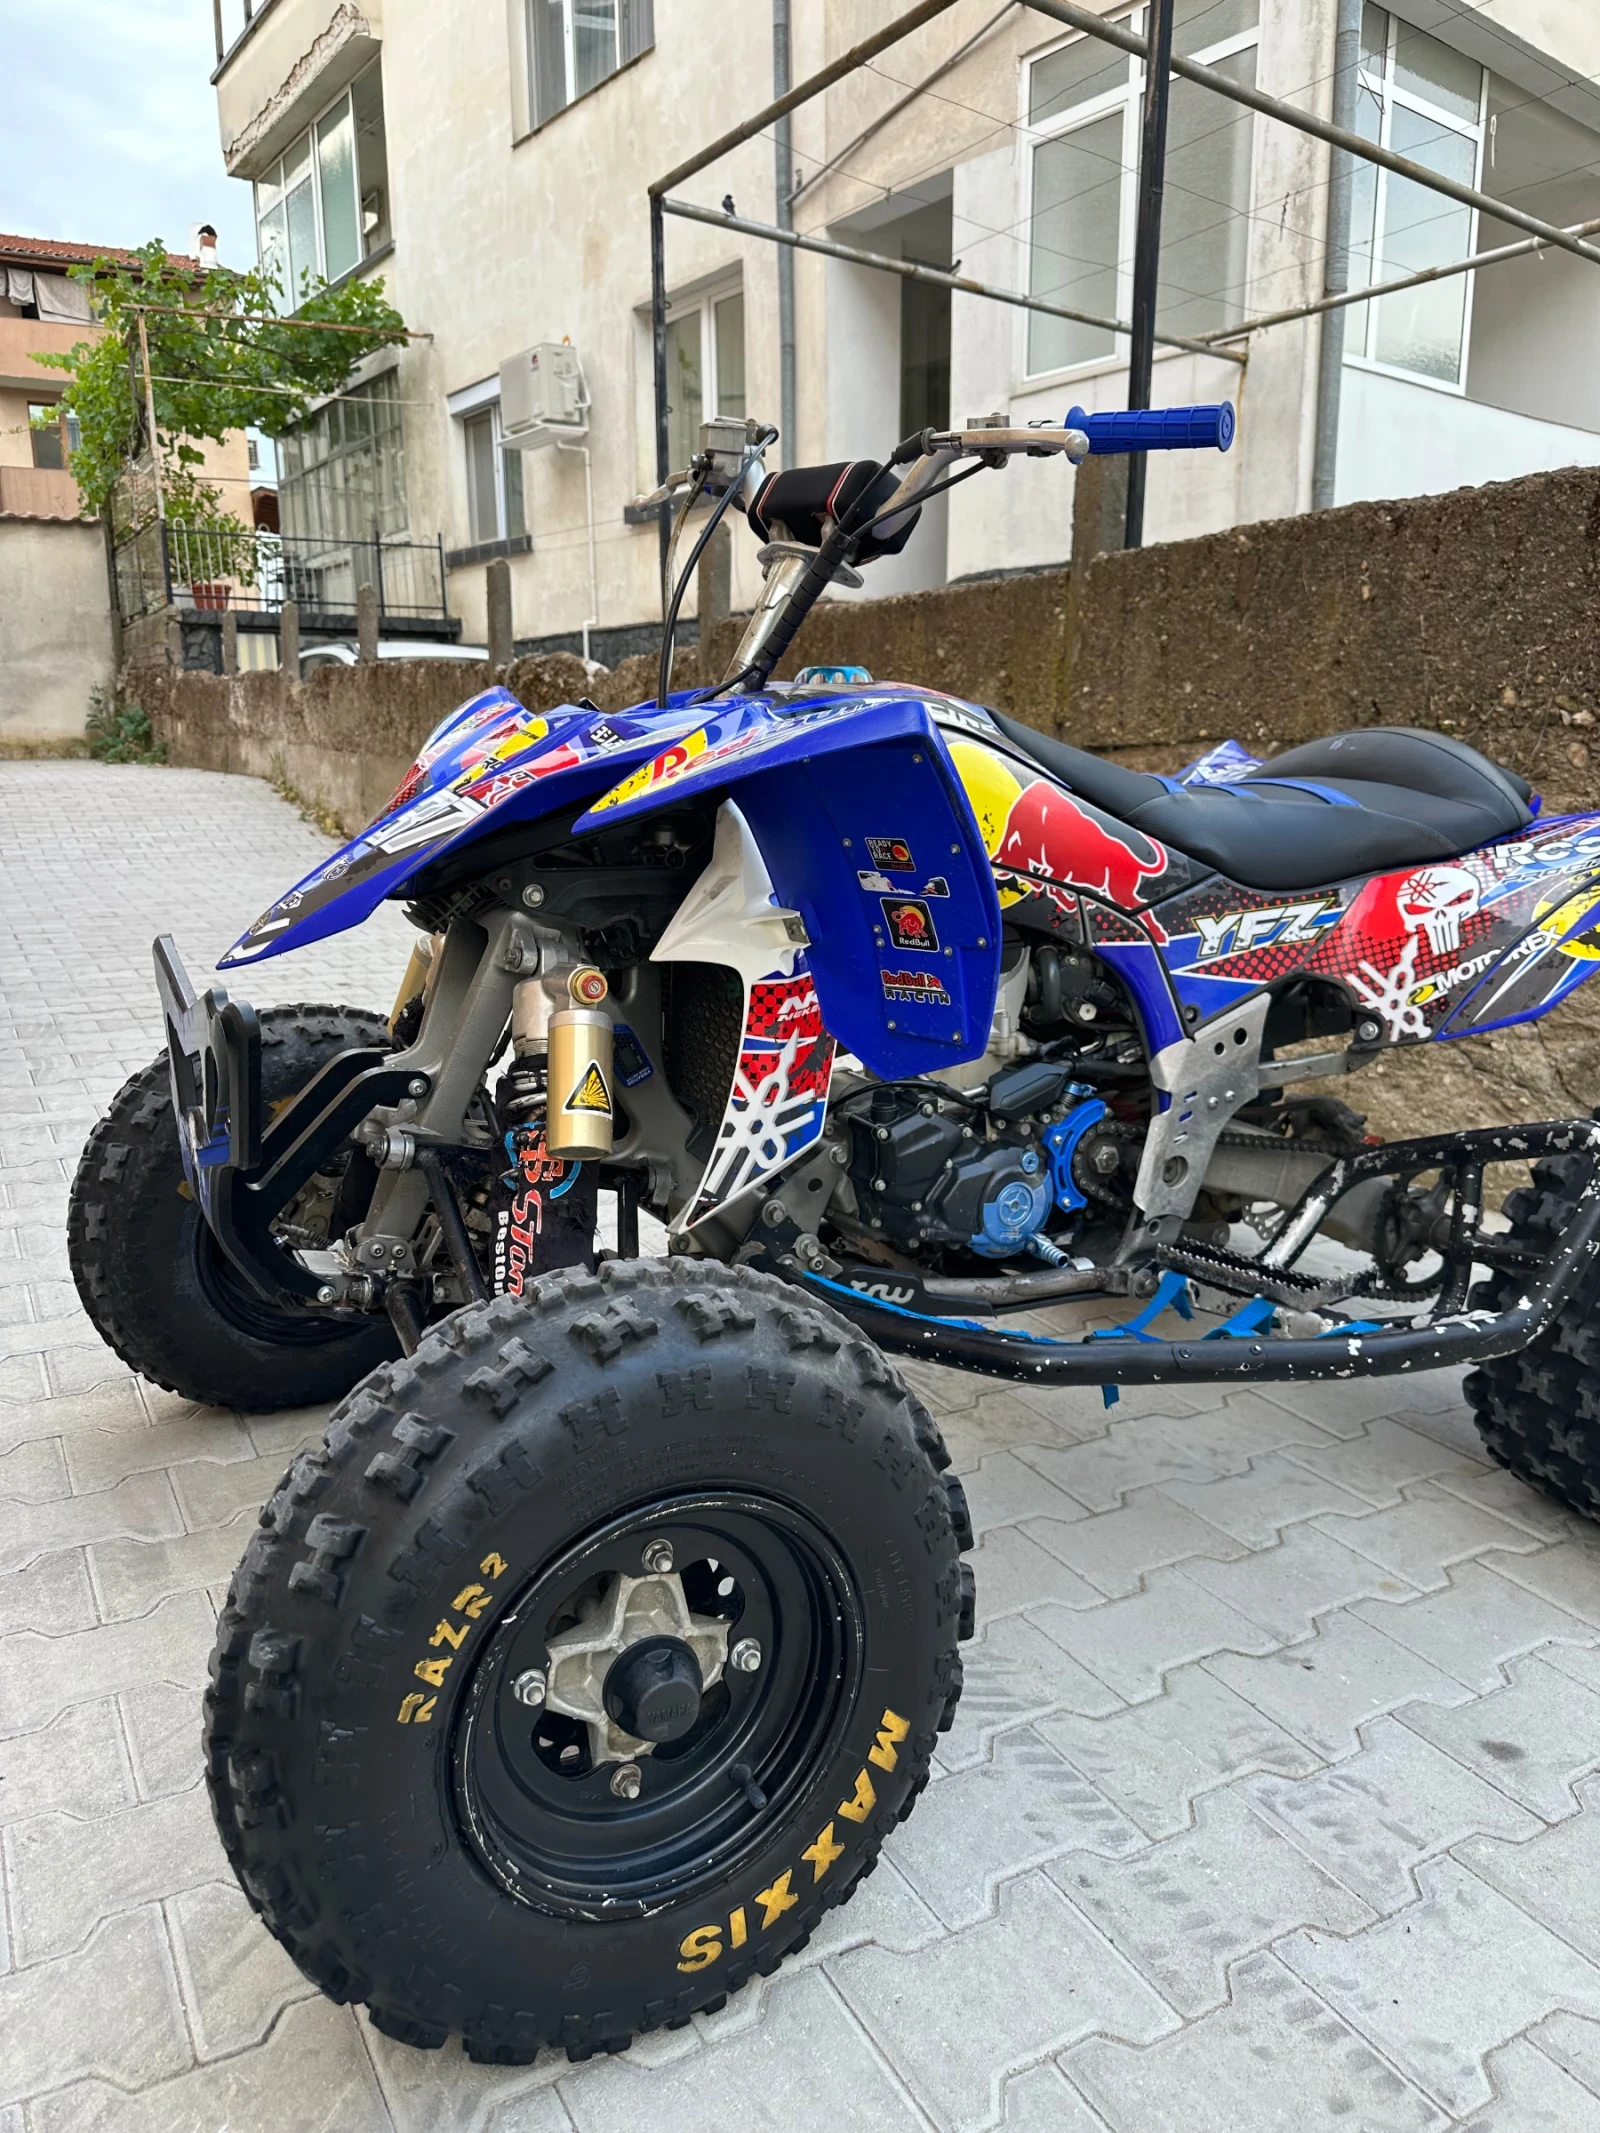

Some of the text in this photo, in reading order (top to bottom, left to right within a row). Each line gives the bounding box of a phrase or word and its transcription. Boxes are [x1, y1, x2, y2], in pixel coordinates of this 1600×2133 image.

[868, 839, 891, 848] READY
[874, 852, 893, 860] RACE
[1192, 898, 1334, 957] YFZ
[647, 1702, 690, 1724] YAMAHA
[676, 1708, 911, 1972] MAXXIS
